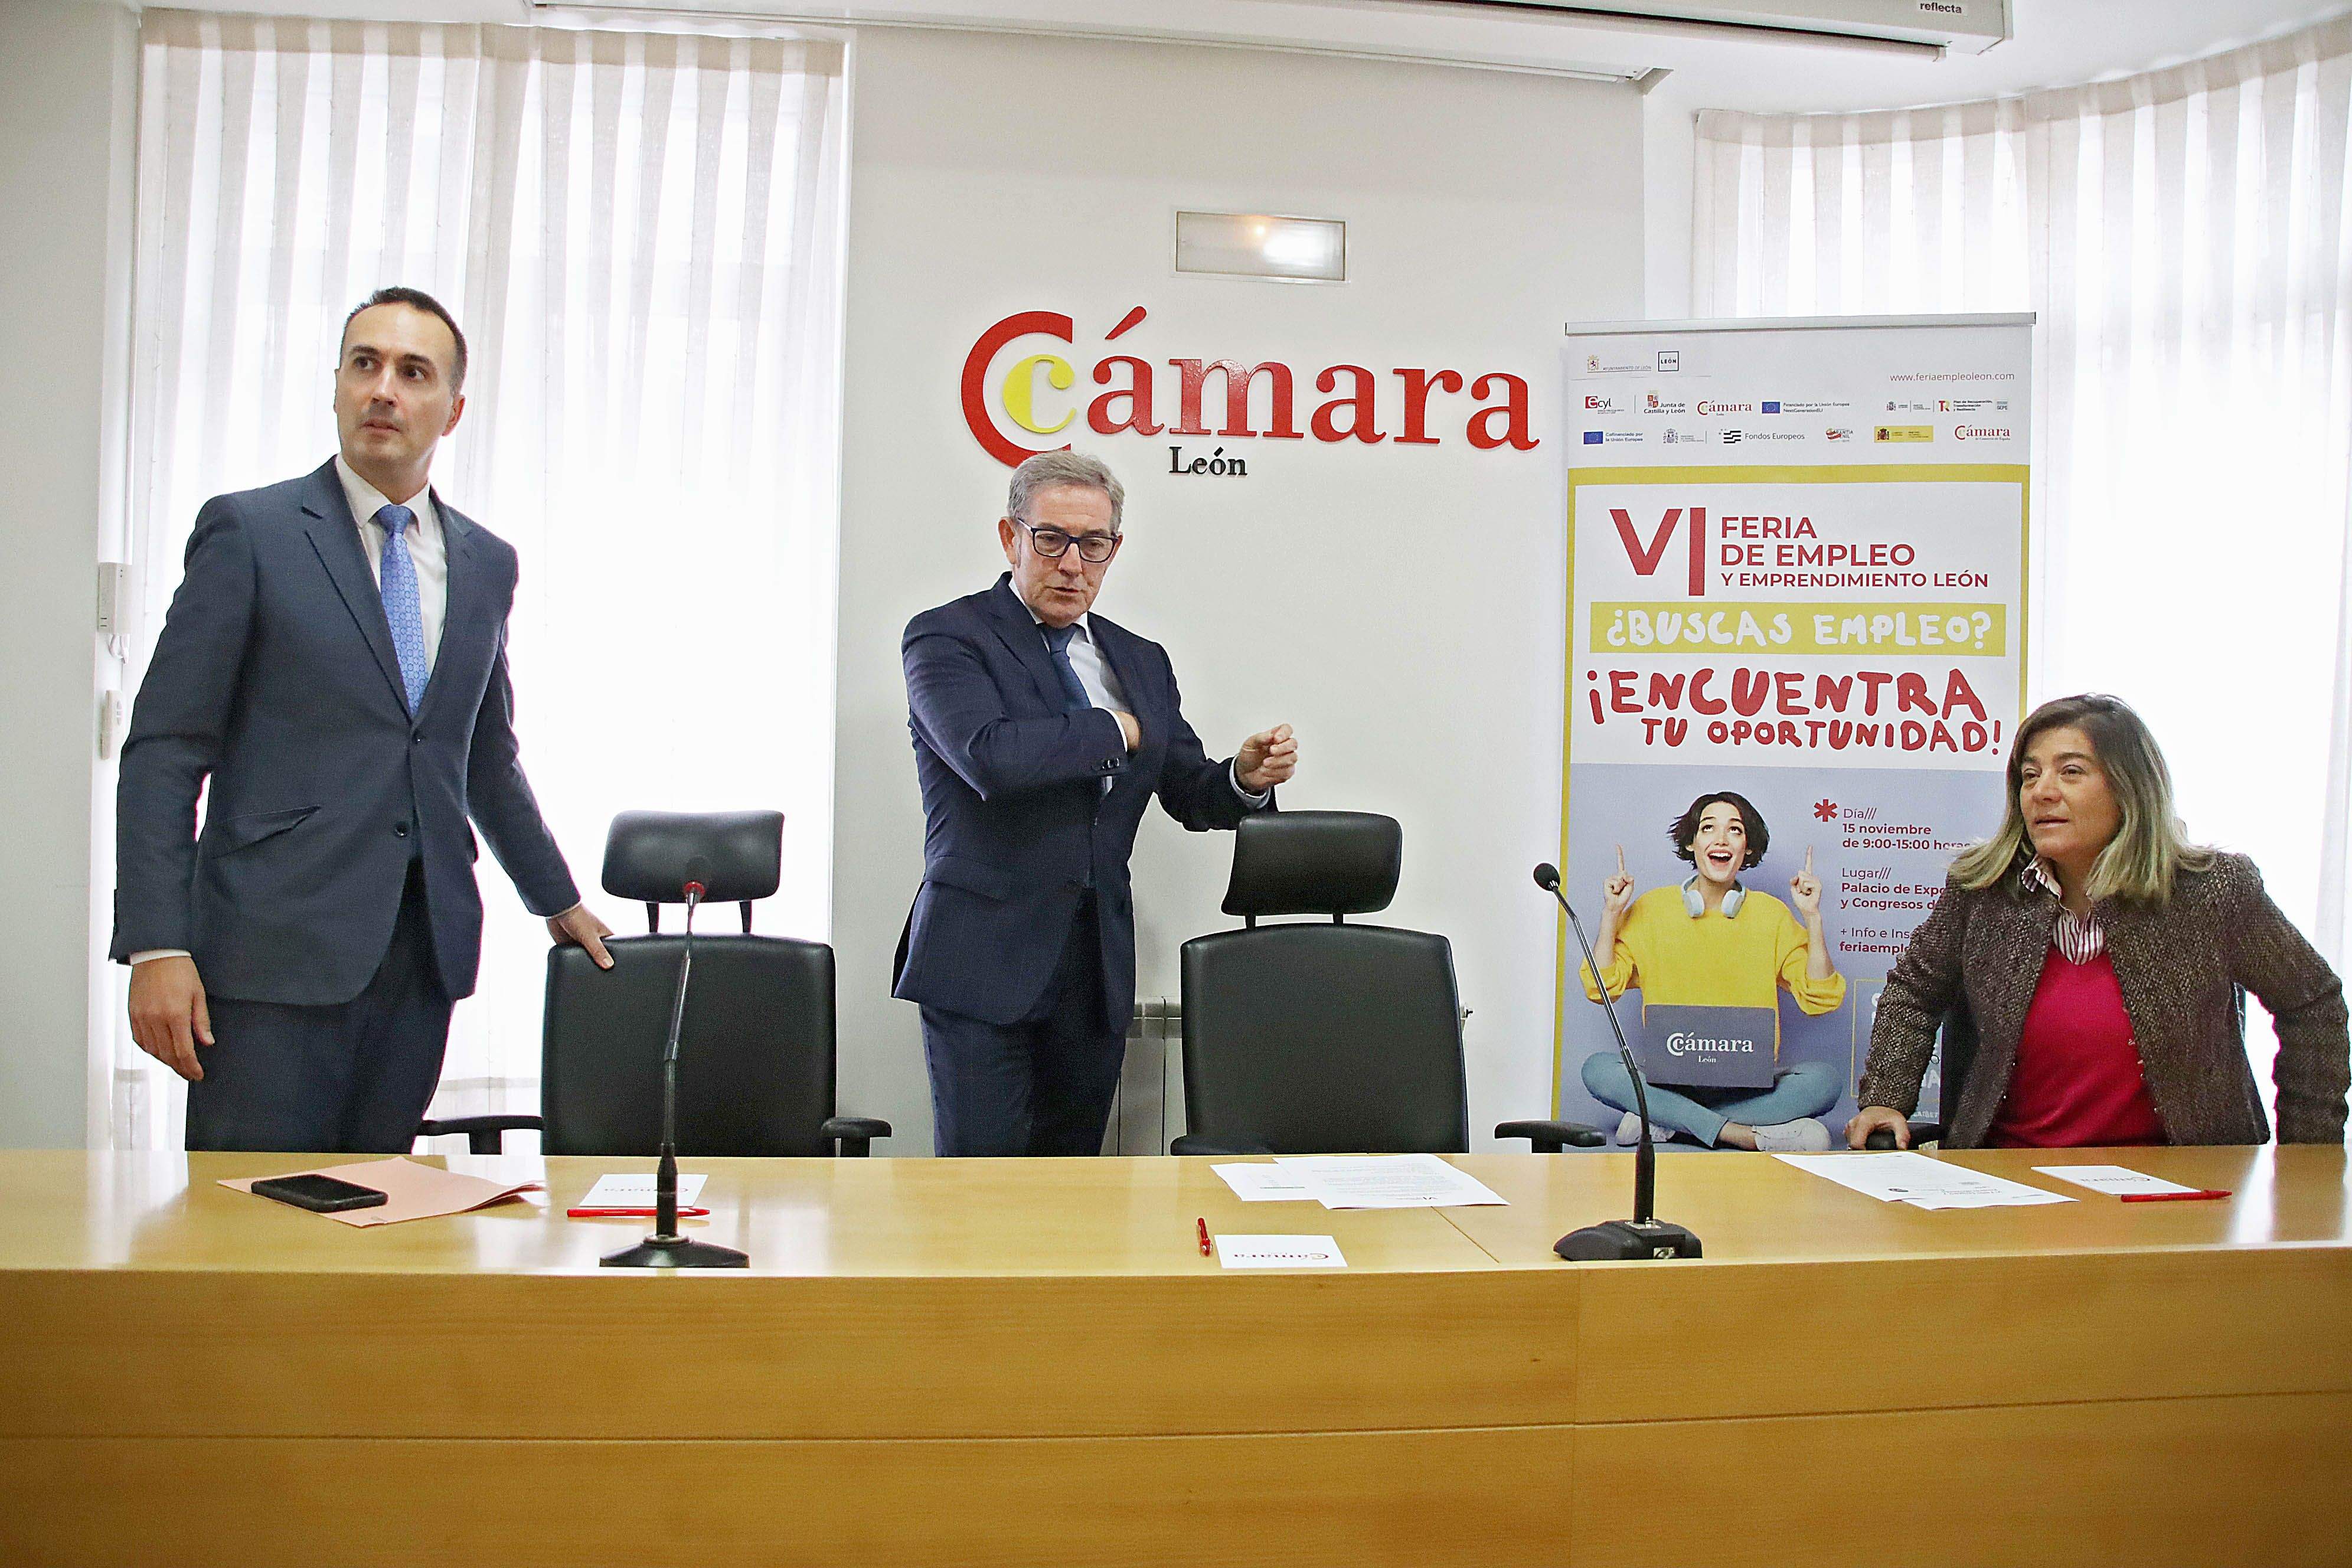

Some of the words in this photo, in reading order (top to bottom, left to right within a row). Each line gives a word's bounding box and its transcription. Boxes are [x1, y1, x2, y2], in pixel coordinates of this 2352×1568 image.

[1919, 1, 1963, 14] reflecta
[1890, 373, 2015, 383] www.feriaempleoleon.com
[1772, 433, 1805, 441] Europeos
[1169, 446, 1248, 477] León
[1720, 516, 1817, 540] FERIA
[1609, 507, 1707, 596] VI
[1720, 544, 1765, 566] DE
[1776, 544, 1915, 567] EMPLEO
[1720, 573, 1733, 587] Y
[1739, 573, 1926, 587] EMPRENDIMIENTO
[1934, 569, 1989, 587] LEÓN
[1606, 609, 1791, 647] ¿BUSCAS
[1814, 611, 1992, 649] EMPLEO?
[1587, 668, 1989, 725] ¡ENCUENTRA
[1641, 717, 1687, 747] TU
[1707, 717, 2001, 755] OPORTUNIDAD!
[1843, 823, 1855, 833] 15
[1859, 824, 1932, 835] noviembre
[1843, 838, 1859, 848] de
[1863, 839, 1930, 850] 9:00-15:00
[1841, 883, 1890, 893] Palacio
[1893, 884, 1910, 894] de
[1841, 899, 1848, 909] y
[1852, 897, 1923, 911] Congresos
[1927, 900, 1937, 909] d
[1851, 927, 1876, 937] Info
[1892, 929, 1910, 939] Ins
